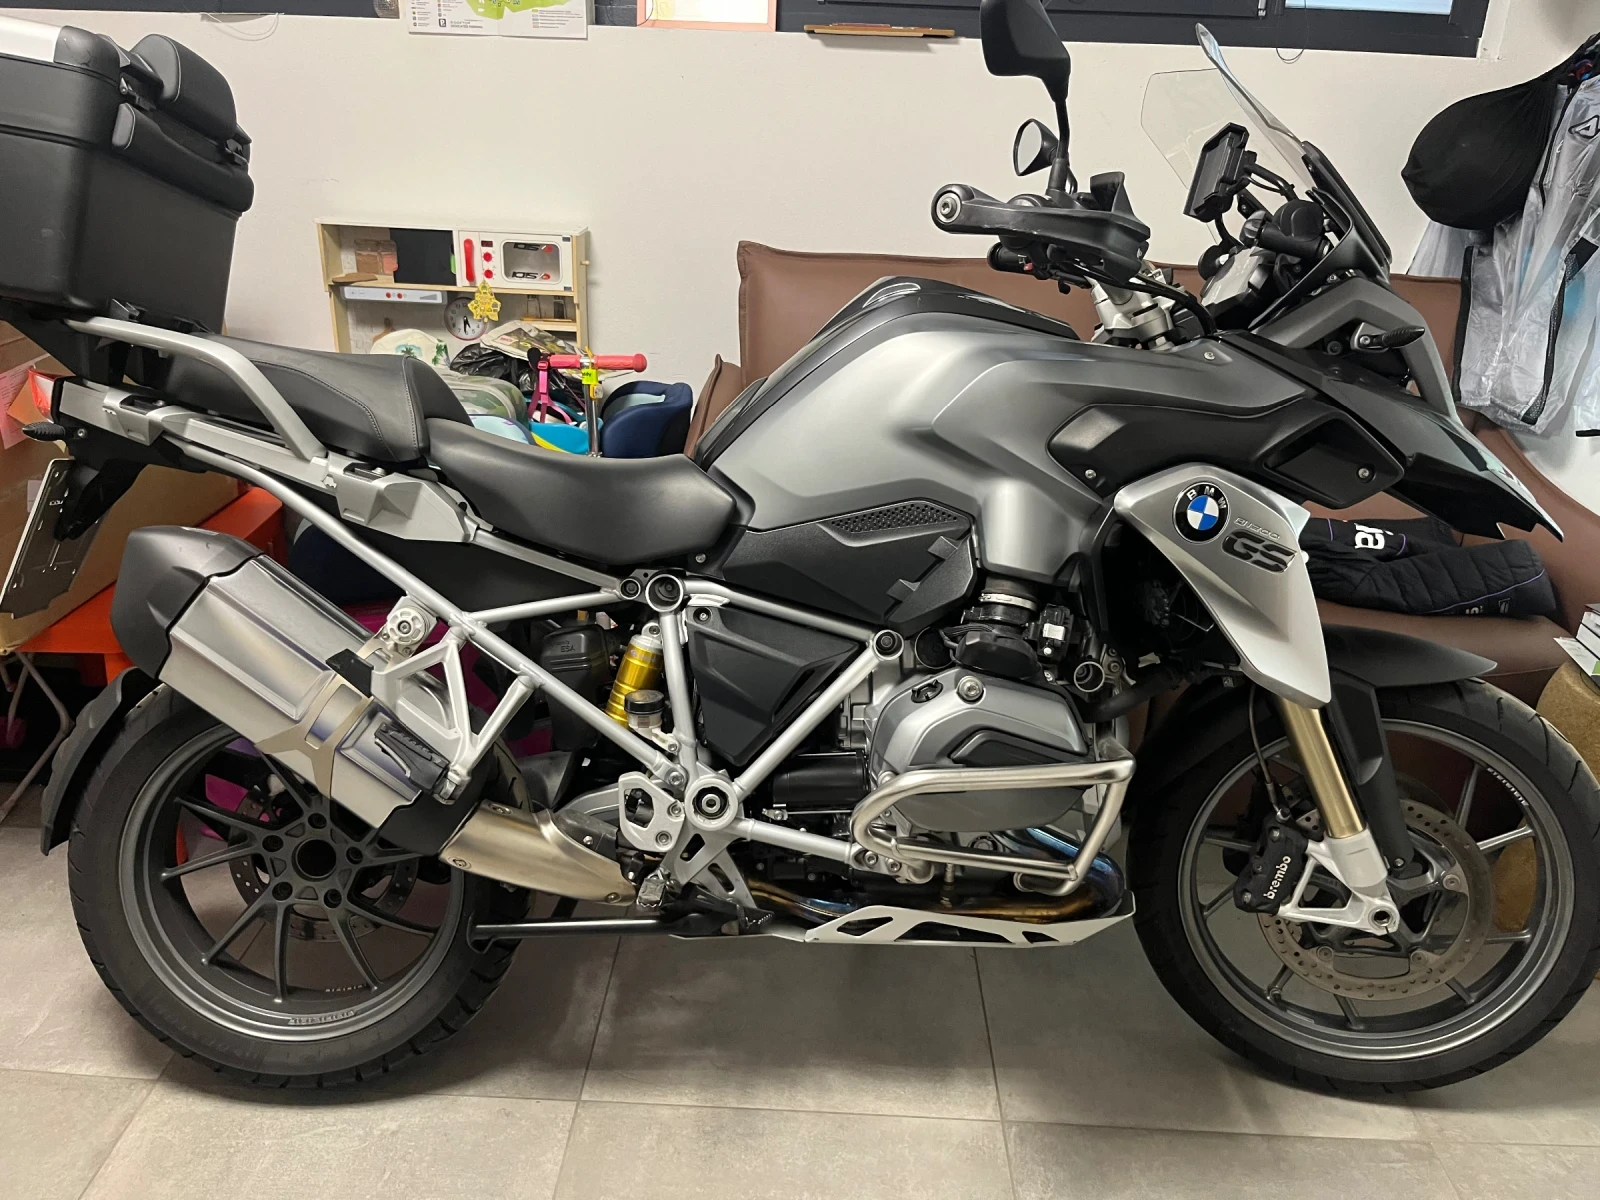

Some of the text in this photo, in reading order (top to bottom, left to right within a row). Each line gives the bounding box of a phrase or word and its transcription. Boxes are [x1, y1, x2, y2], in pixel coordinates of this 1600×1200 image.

[1186, 485, 1227, 510] BMW
[1222, 529, 1297, 573] GS
[1263, 855, 1292, 900] brembo
